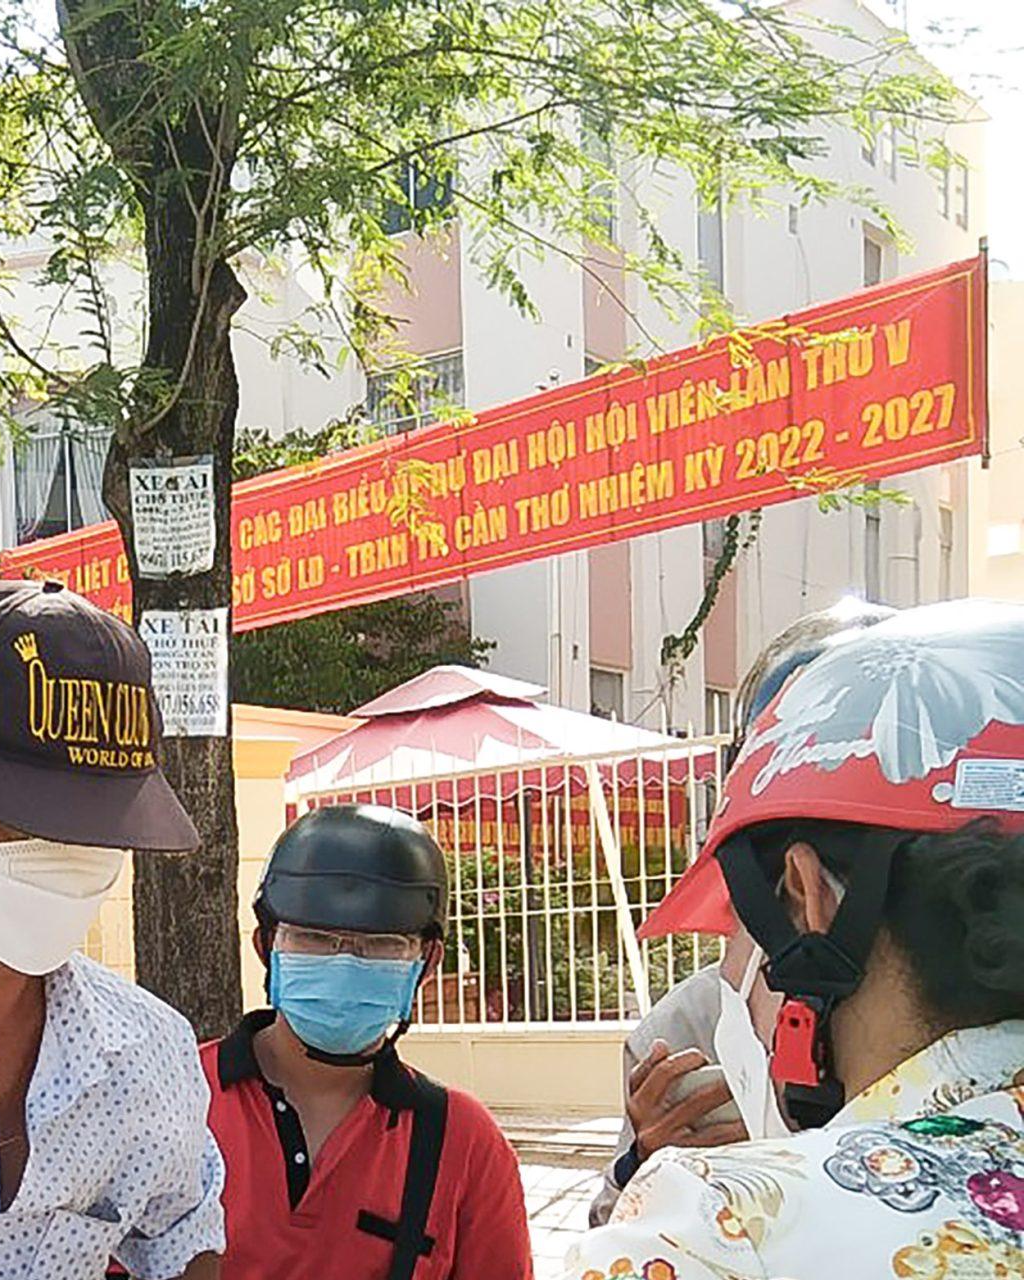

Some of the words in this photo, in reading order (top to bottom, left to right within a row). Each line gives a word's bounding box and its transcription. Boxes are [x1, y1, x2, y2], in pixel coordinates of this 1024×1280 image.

[76, 556, 112, 595] LIỆT
[240, 509, 282, 552] CÁC
[288, 496, 327, 539] ĐẠI
[333, 473, 387, 527] BIỂU
[472, 438, 520, 486] ĐẠI
[527, 419, 576, 470] HỘI
[585, 401, 637, 452] HỘI
[646, 377, 718, 435] VIÊN
[882, 319, 912, 366] V
[136, 474, 163, 491] XE
[262, 555, 291, 600] SỞ
[455, 500, 507, 551] CẦN
[513, 482, 570, 536] THƠ
[578, 461, 675, 520] NHIỆM
[684, 443, 725, 494] KỲ
[735, 419, 825, 480] 2022
[835, 431, 850, 443] -
[860, 382, 957, 448] 2027
[143, 618, 174, 634] XE
[29, 658, 113, 743] QUEEN
[67, 746, 129, 768] WORLD
